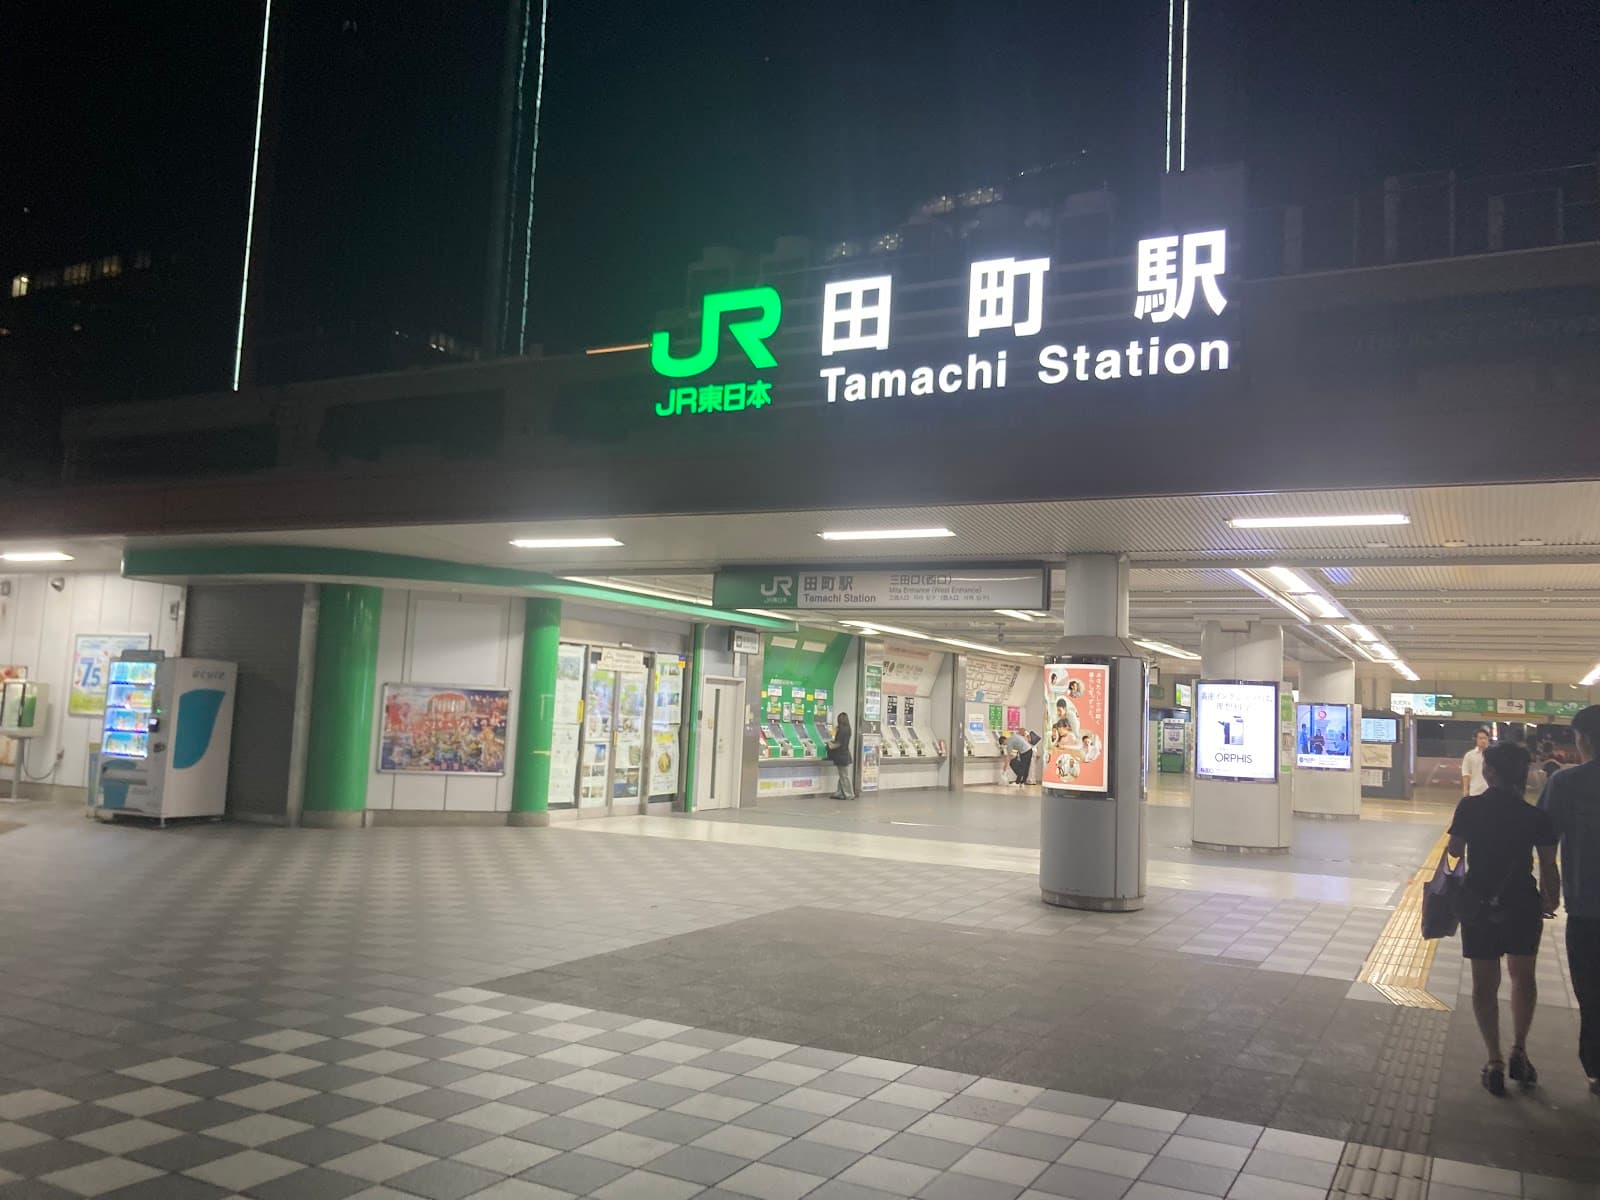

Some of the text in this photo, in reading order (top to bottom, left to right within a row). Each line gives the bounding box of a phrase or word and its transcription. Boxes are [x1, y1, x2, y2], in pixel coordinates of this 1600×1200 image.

[821, 229, 1227, 355] 田町駅
[652, 286, 782, 377] JR
[820, 336, 1230, 403] Tamachi Station
[655, 380, 773, 417] JR東日本
[760, 575, 793, 597] JR
[804, 575, 854, 592] 田町駅
[889, 574, 952, 586] 三田口(西口)
[803, 592, 877, 603] Tamachi Station
[1215, 752, 1253, 764] ORPHIS
